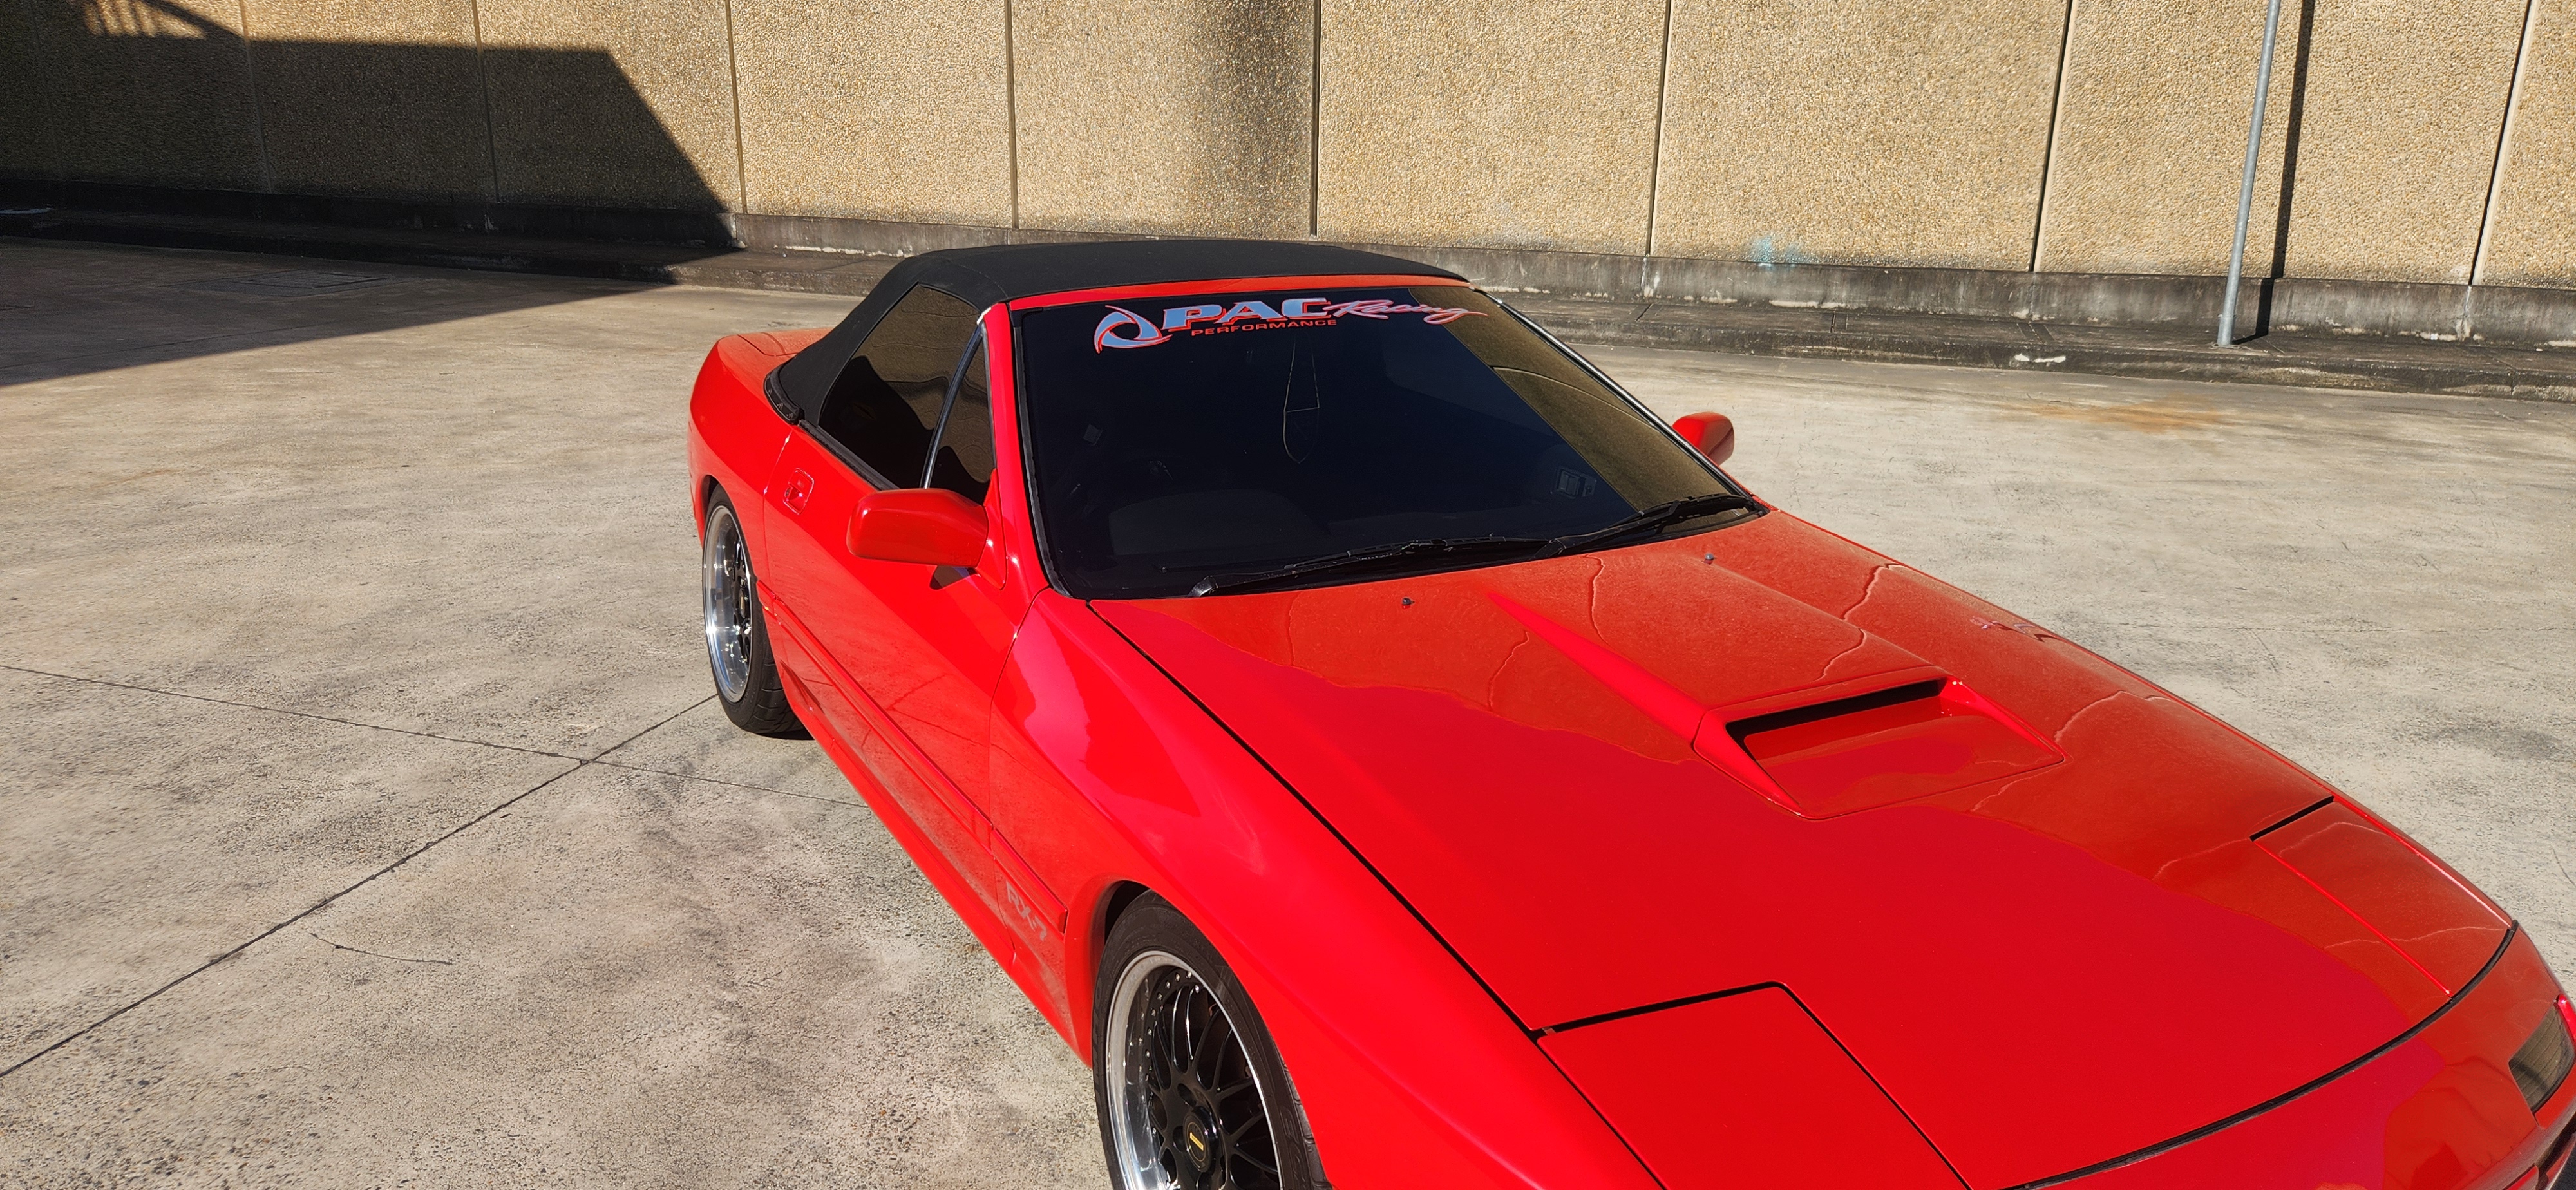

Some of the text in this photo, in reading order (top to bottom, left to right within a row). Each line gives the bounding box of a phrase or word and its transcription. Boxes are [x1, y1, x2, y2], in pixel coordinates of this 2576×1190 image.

[1160, 298, 1489, 332] PAC Racing
[1191, 319, 1337, 336] PERFORMANCE
